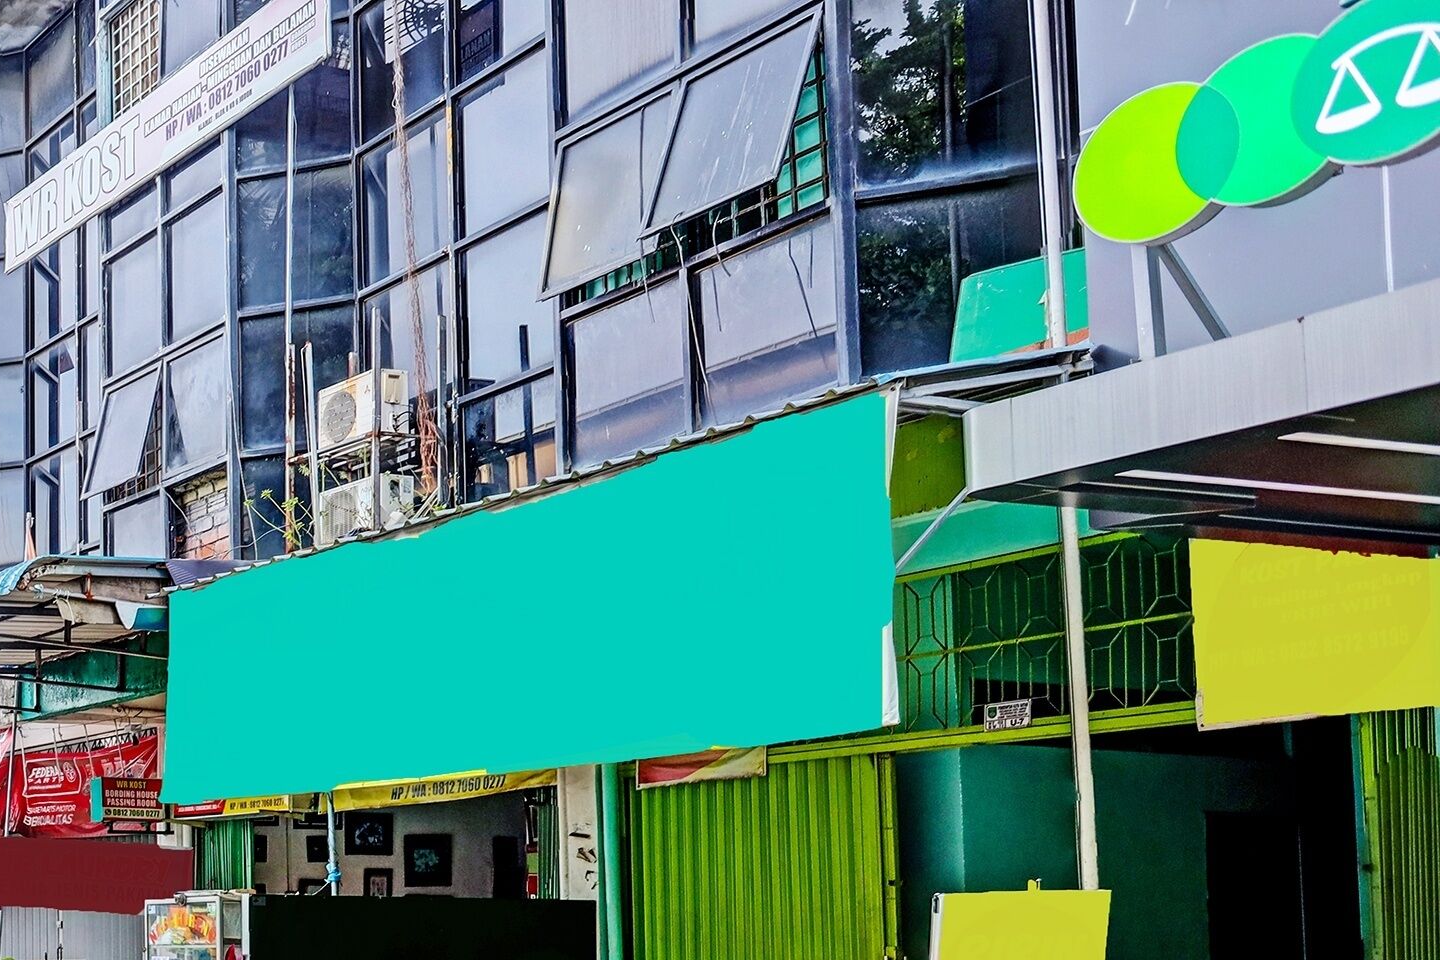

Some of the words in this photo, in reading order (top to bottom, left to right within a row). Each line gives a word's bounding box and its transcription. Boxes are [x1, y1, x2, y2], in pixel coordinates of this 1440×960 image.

[199, 27, 250, 78] DISEWAKAN
[166, 122, 178, 141] HP
[186, 105, 202, 127] WA
[209, 82, 233, 111] 0812
[235, 65, 261, 92] 7060
[263, 39, 289, 72] 0277
[14, 186, 58, 257] WR
[63, 115, 140, 223] KOST
[28, 766, 63, 779] FEDERAL
[116, 780, 128, 788] WR
[129, 780, 146, 789] KOST
[391, 788, 404, 800] HP
[411, 785, 427, 798] WA
[432, 782, 455, 796] 0812
[457, 779, 480, 793] 7060
[482, 775, 506, 790] 0277
[105, 790, 134, 798] BORDING
[136, 790, 157, 799] HOUSE
[107, 799, 135, 807] PASSING
[136, 799, 156, 807] ROOM
